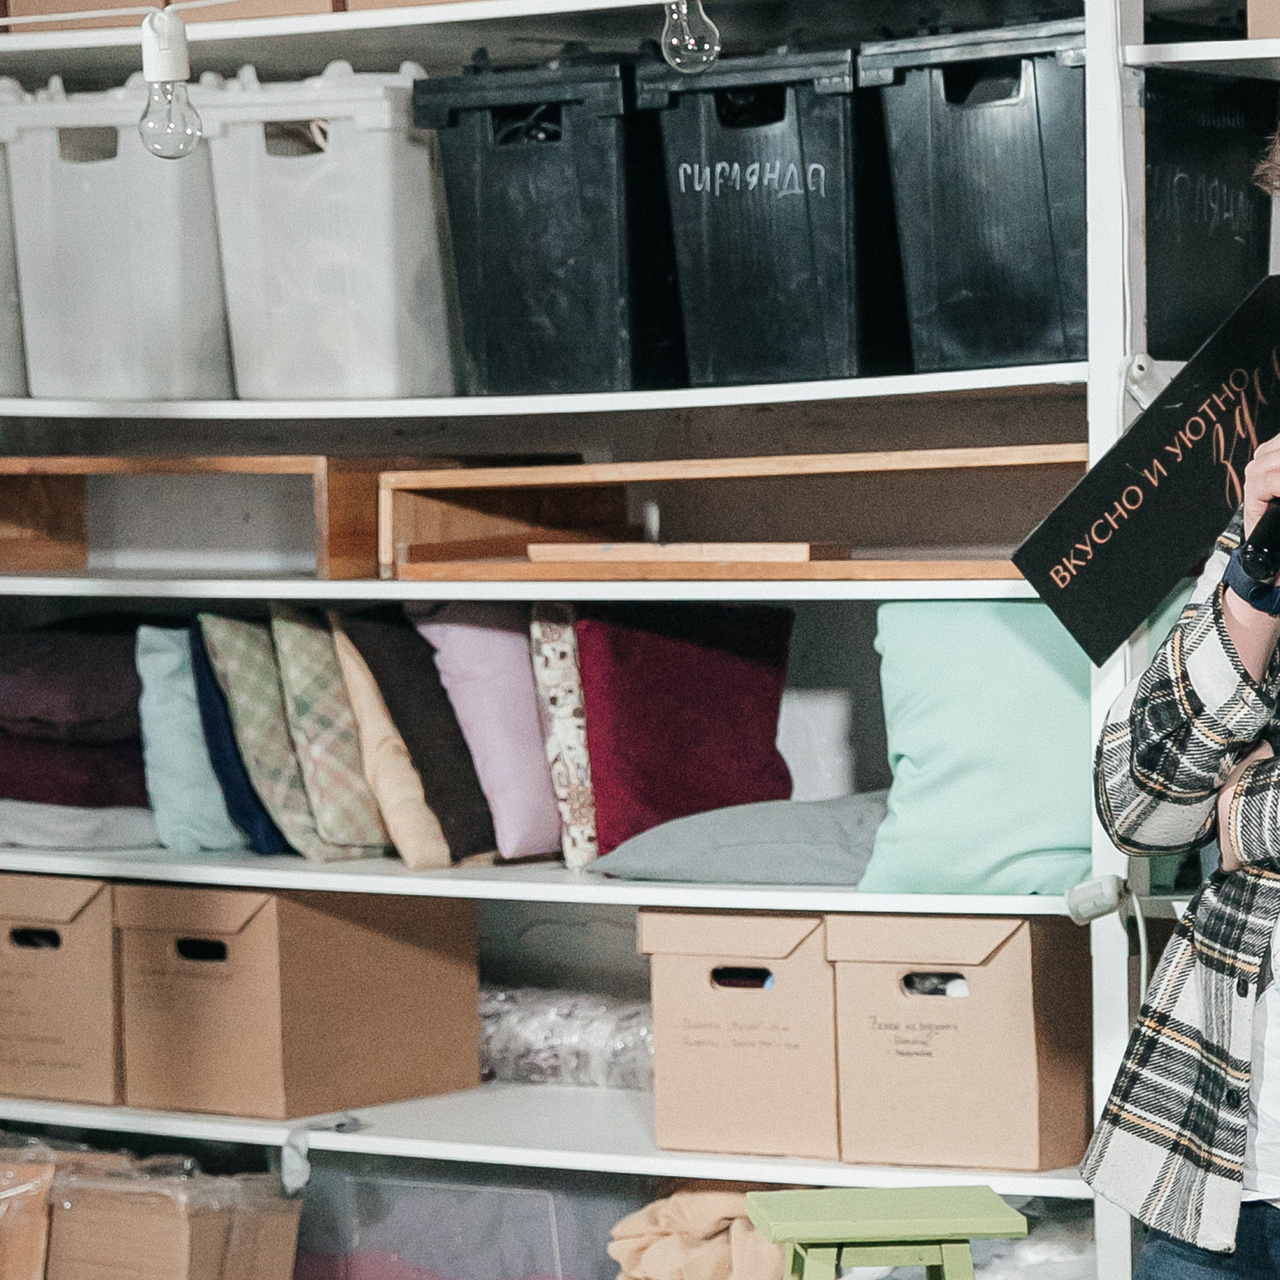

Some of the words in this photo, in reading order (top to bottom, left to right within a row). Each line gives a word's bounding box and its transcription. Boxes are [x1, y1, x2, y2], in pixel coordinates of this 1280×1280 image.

[1049, 485, 1144, 590] ВКУСНО
[1143, 457, 1169, 488] И
[1165, 368, 1250, 463] УЮТНО
